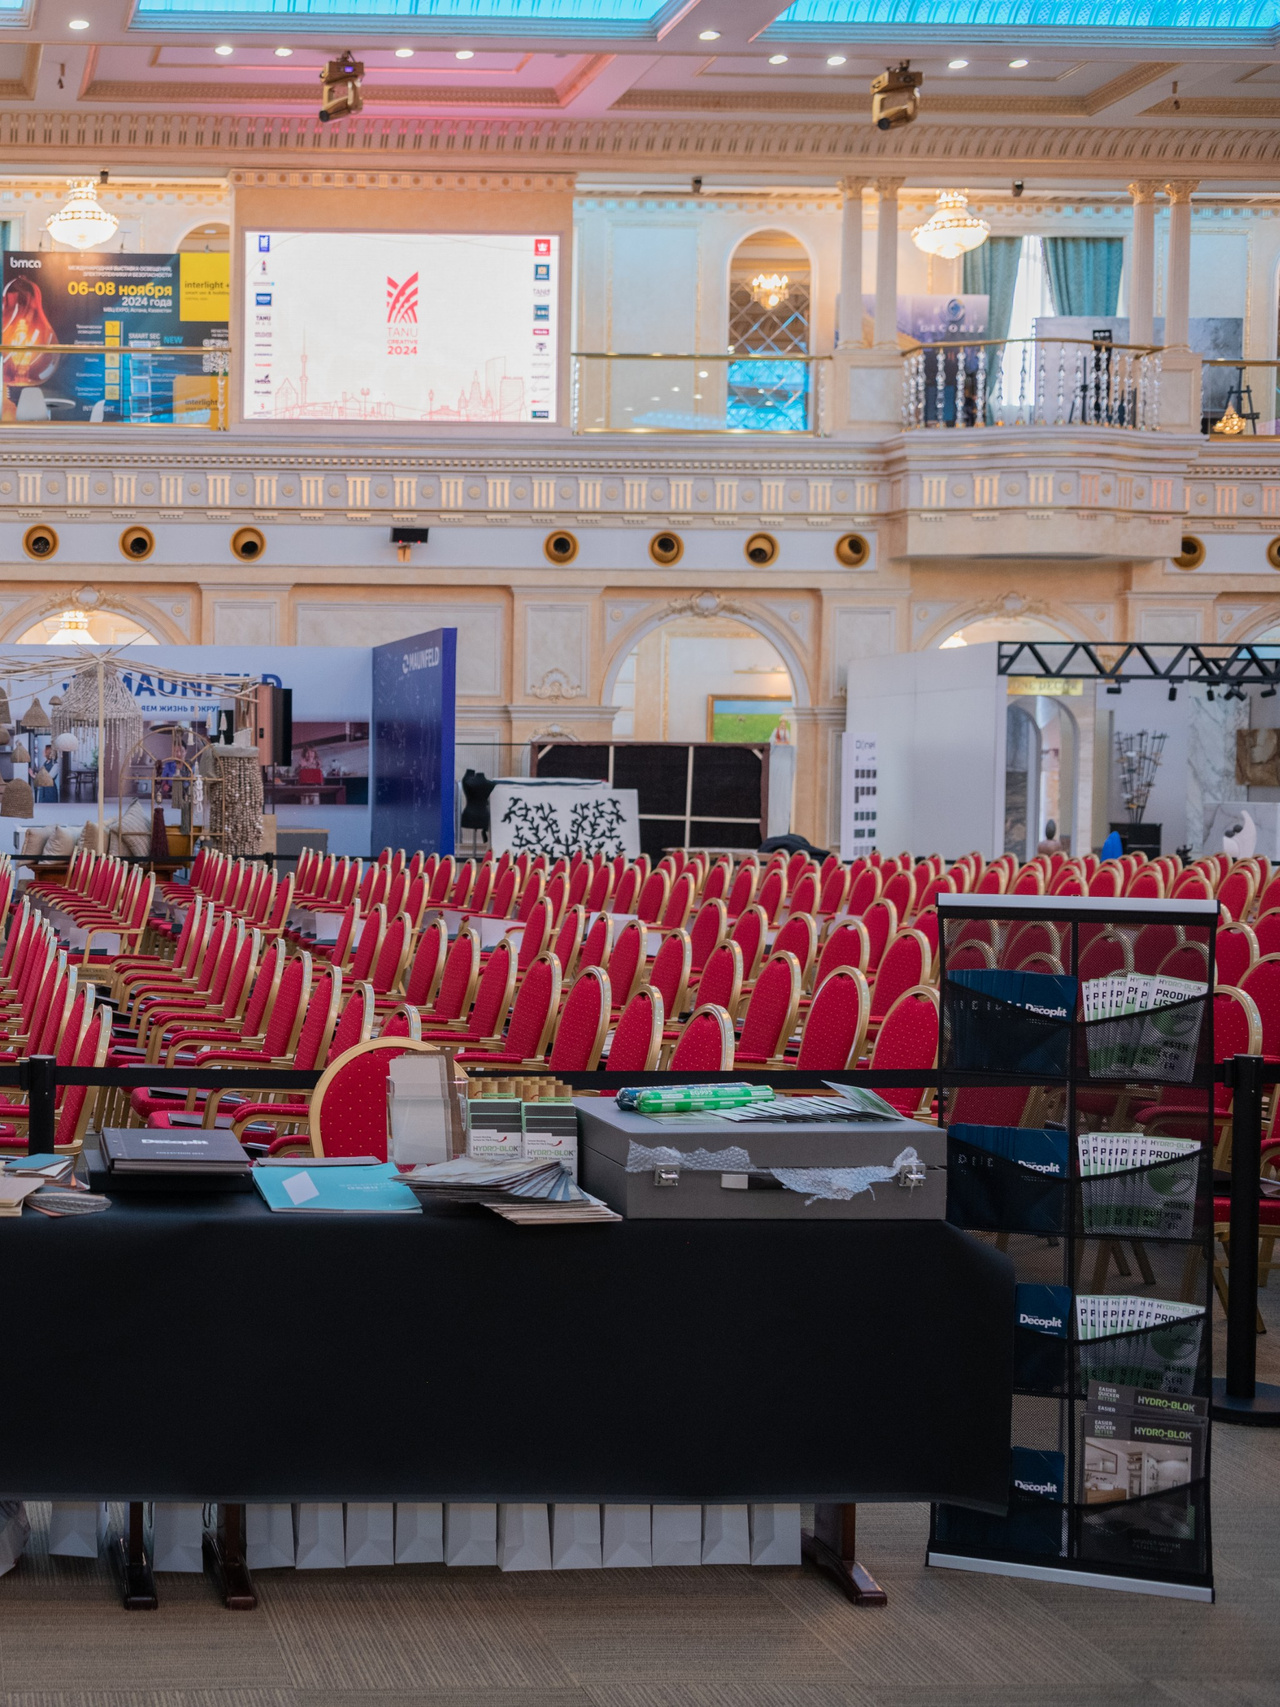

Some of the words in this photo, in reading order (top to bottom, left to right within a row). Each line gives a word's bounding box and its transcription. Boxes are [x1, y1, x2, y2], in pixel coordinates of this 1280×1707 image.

[10, 257, 41, 269] bmca
[67, 281, 116, 296] 06-08
[118, 283, 172, 299] ноября
[185, 280, 224, 290] interlight
[122, 297, 148, 307] 2024
[150, 298, 172, 308] года
[128, 332, 149, 340] SMART
[387, 327, 418, 338] TANU
[163, 336, 184, 344] NEW
[387, 345, 418, 355] 2024
[409, 647, 440, 672] MAUNFELD
[159, 705, 189, 713] ЖИЗНЬ
[1159, 978, 1203, 992] HYDRO-BLOK
[141, 1138, 209, 1146] Decoplit
[1019, 1313, 1062, 1329] Decoplit
[1098, 1386, 1117, 1394] EASIER
[1098, 1405, 1116, 1413] EASIER
[1138, 1396, 1195, 1412] HYDRO-BLOK
[1134, 1426, 1192, 1440] HYDRO-BLOK
